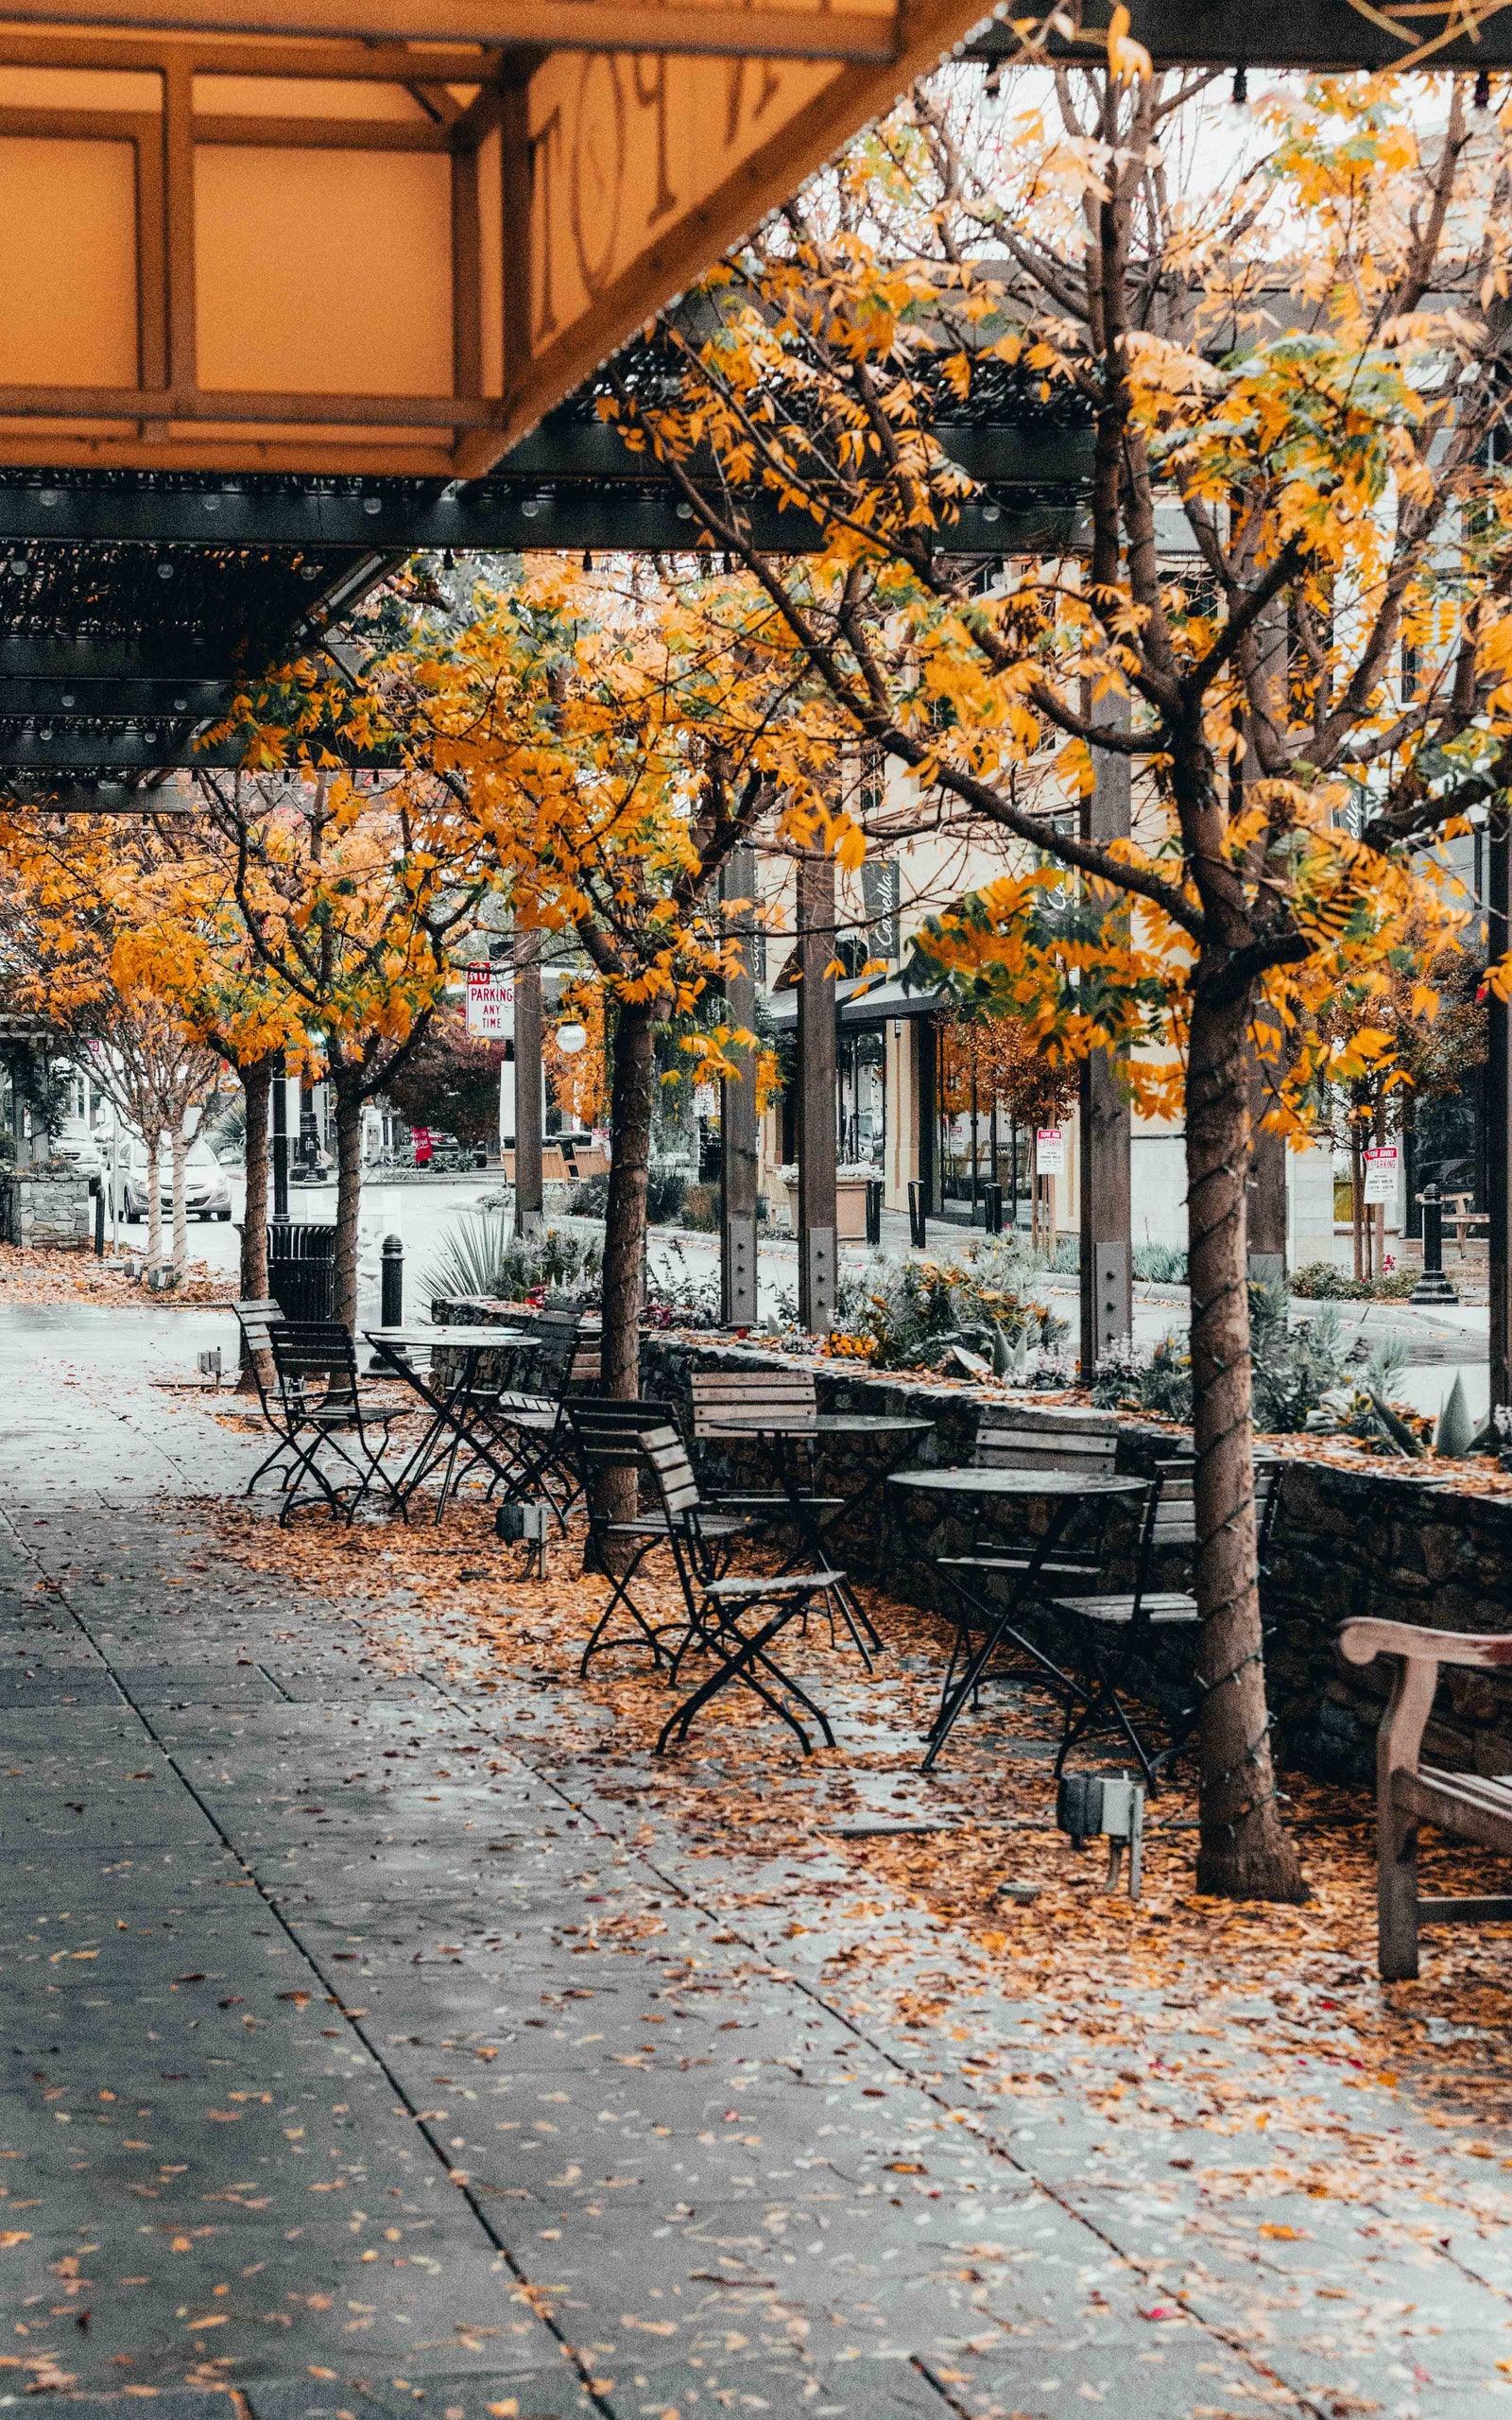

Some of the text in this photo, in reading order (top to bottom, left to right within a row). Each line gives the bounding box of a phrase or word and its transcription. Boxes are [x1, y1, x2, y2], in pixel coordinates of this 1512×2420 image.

[471, 988, 513, 1002] PARKING
[483, 1005, 500, 1014] ANY
[482, 1018, 502, 1028] TIME
